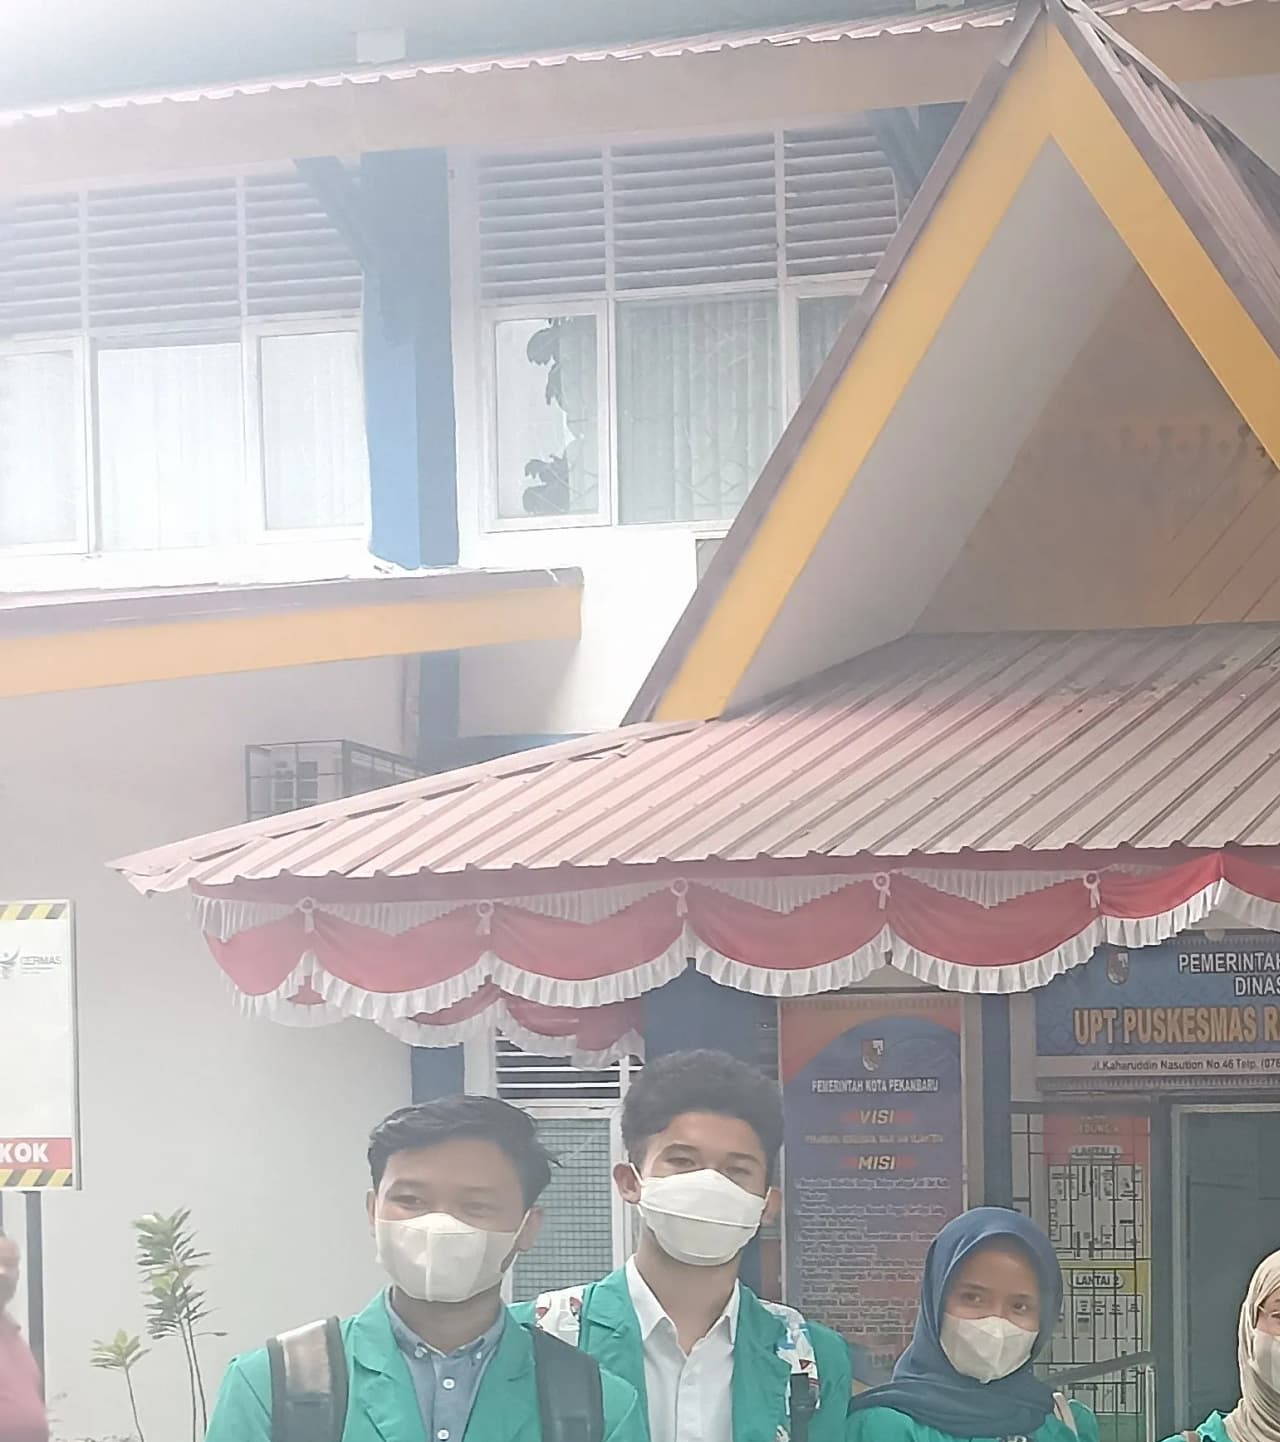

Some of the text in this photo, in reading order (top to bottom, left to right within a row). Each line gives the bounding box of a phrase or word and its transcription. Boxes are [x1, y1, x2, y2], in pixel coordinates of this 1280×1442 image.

[1073, 1008, 1117, 1045] UPT
[1122, 1006, 1258, 1045] PUSKESMAS
[811, 1080, 864, 1093] PEMERINTAH
[865, 1079, 887, 1093] KOTA
[857, 1110, 895, 1125] VISI
[857, 1155, 896, 1171] MISI
